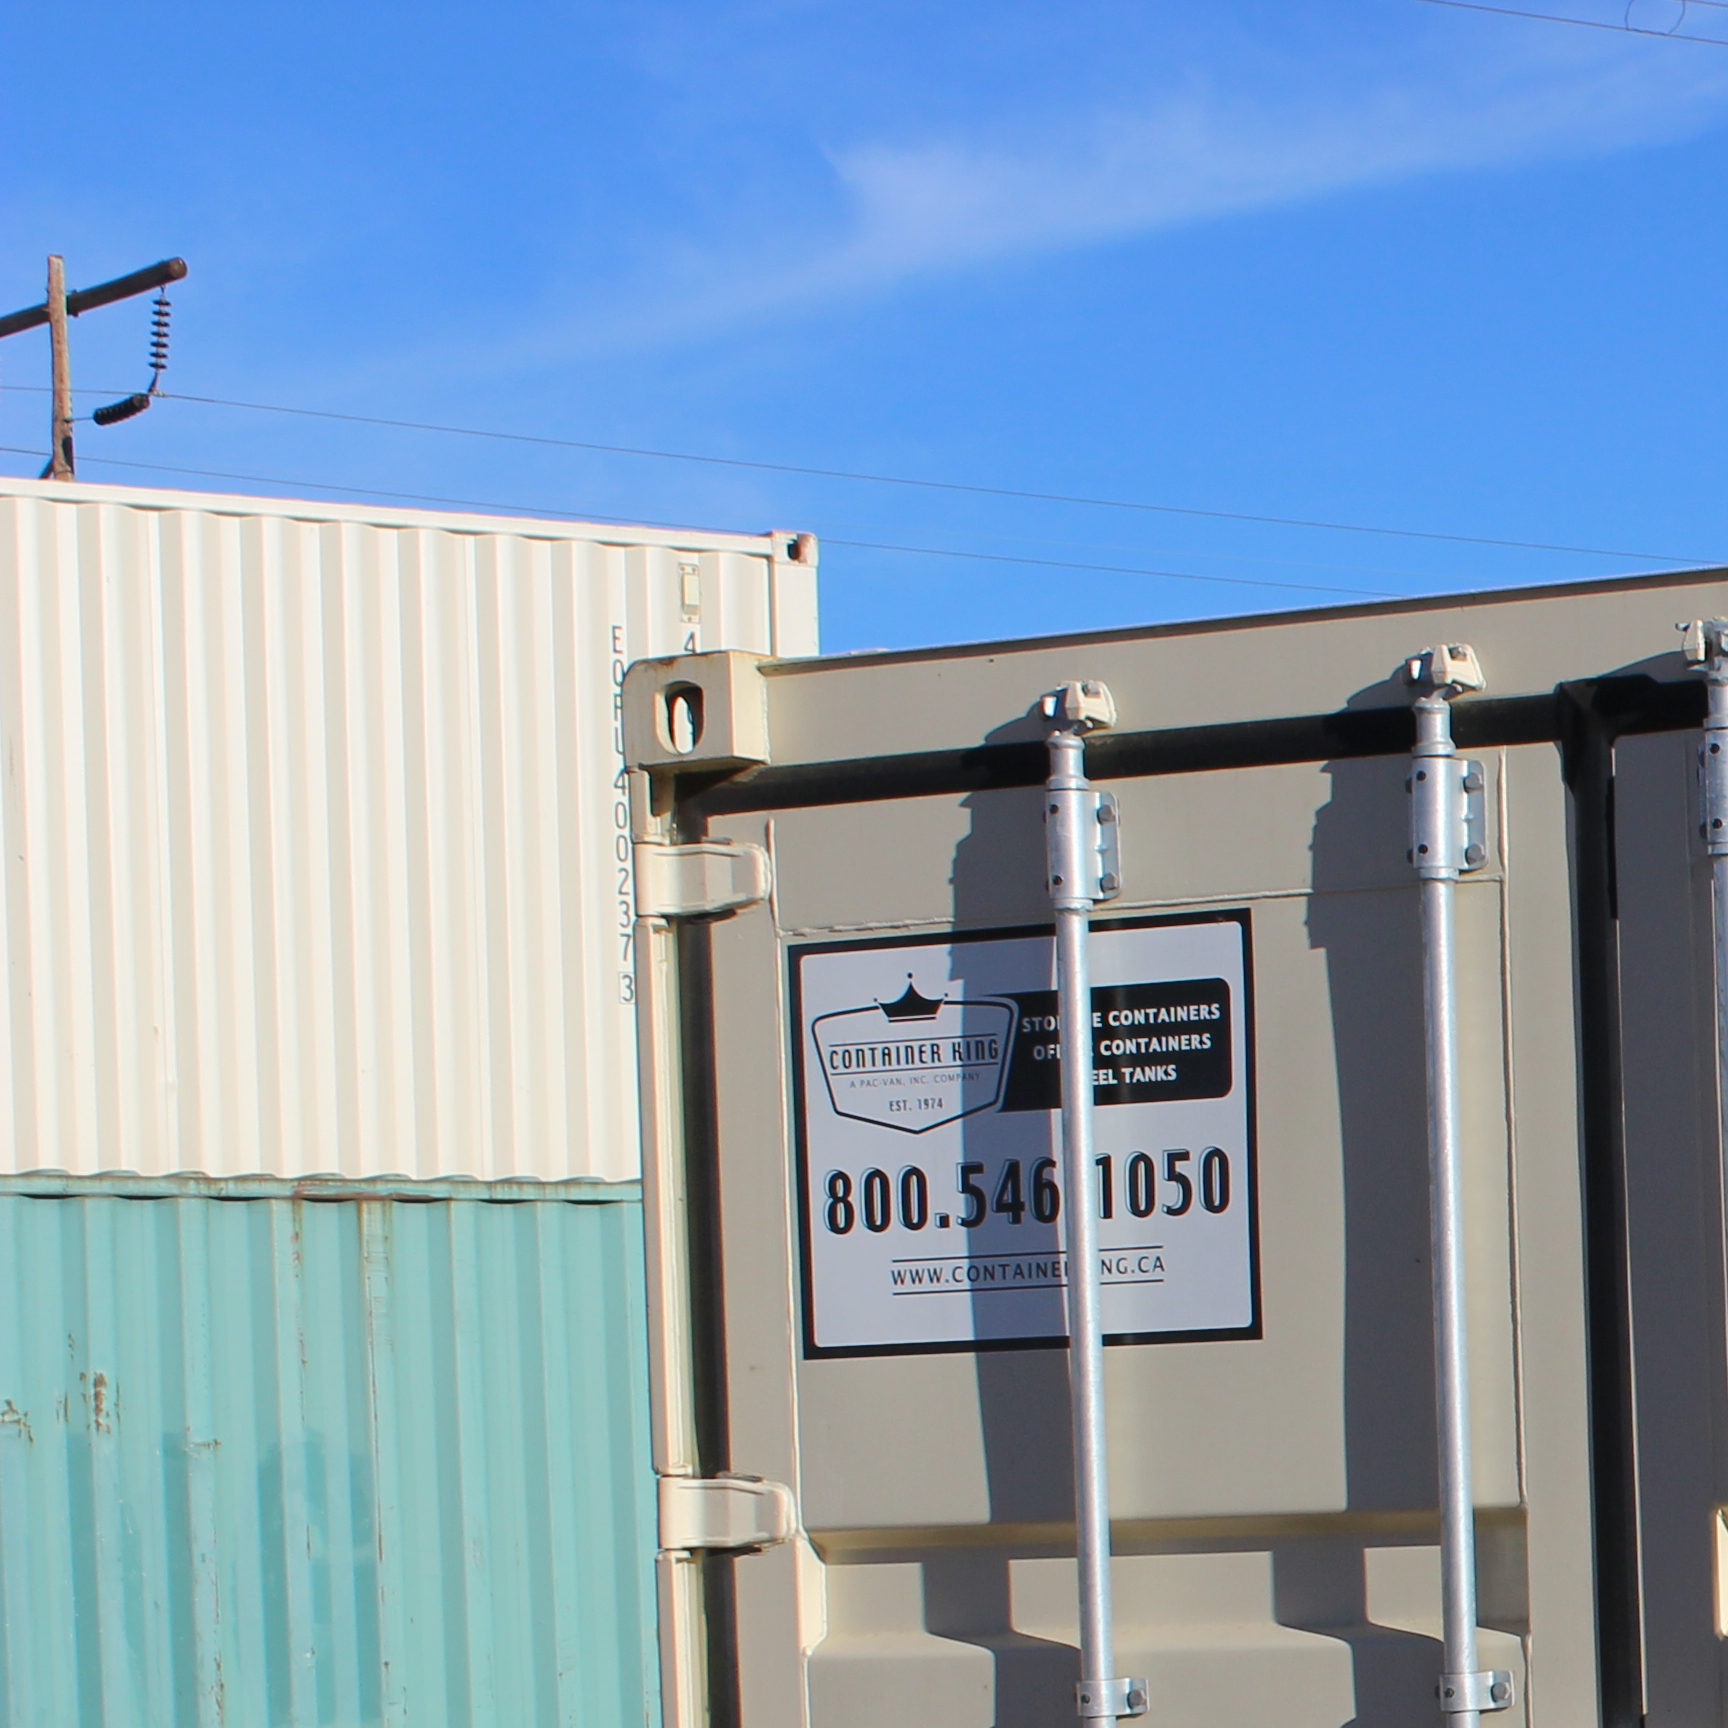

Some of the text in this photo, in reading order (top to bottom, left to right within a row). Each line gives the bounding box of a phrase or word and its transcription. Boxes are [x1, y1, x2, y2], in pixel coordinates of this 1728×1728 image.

[1021, 1003, 1221, 1033] STOE CONTAINERS
[829, 1038, 999, 1070] CONTAINER KING
[1099, 1033, 1212, 1057] CONTAINERS
[850, 1080, 857, 1089] A
[910, 1075, 930, 1085] INC.
[934, 1072, 982, 1084] COMPANY
[1121, 1063, 1178, 1084] TANKS
[889, 1097, 944, 1112] EST. 1974
[823, 1146, 1231, 1235] 800.5461050
